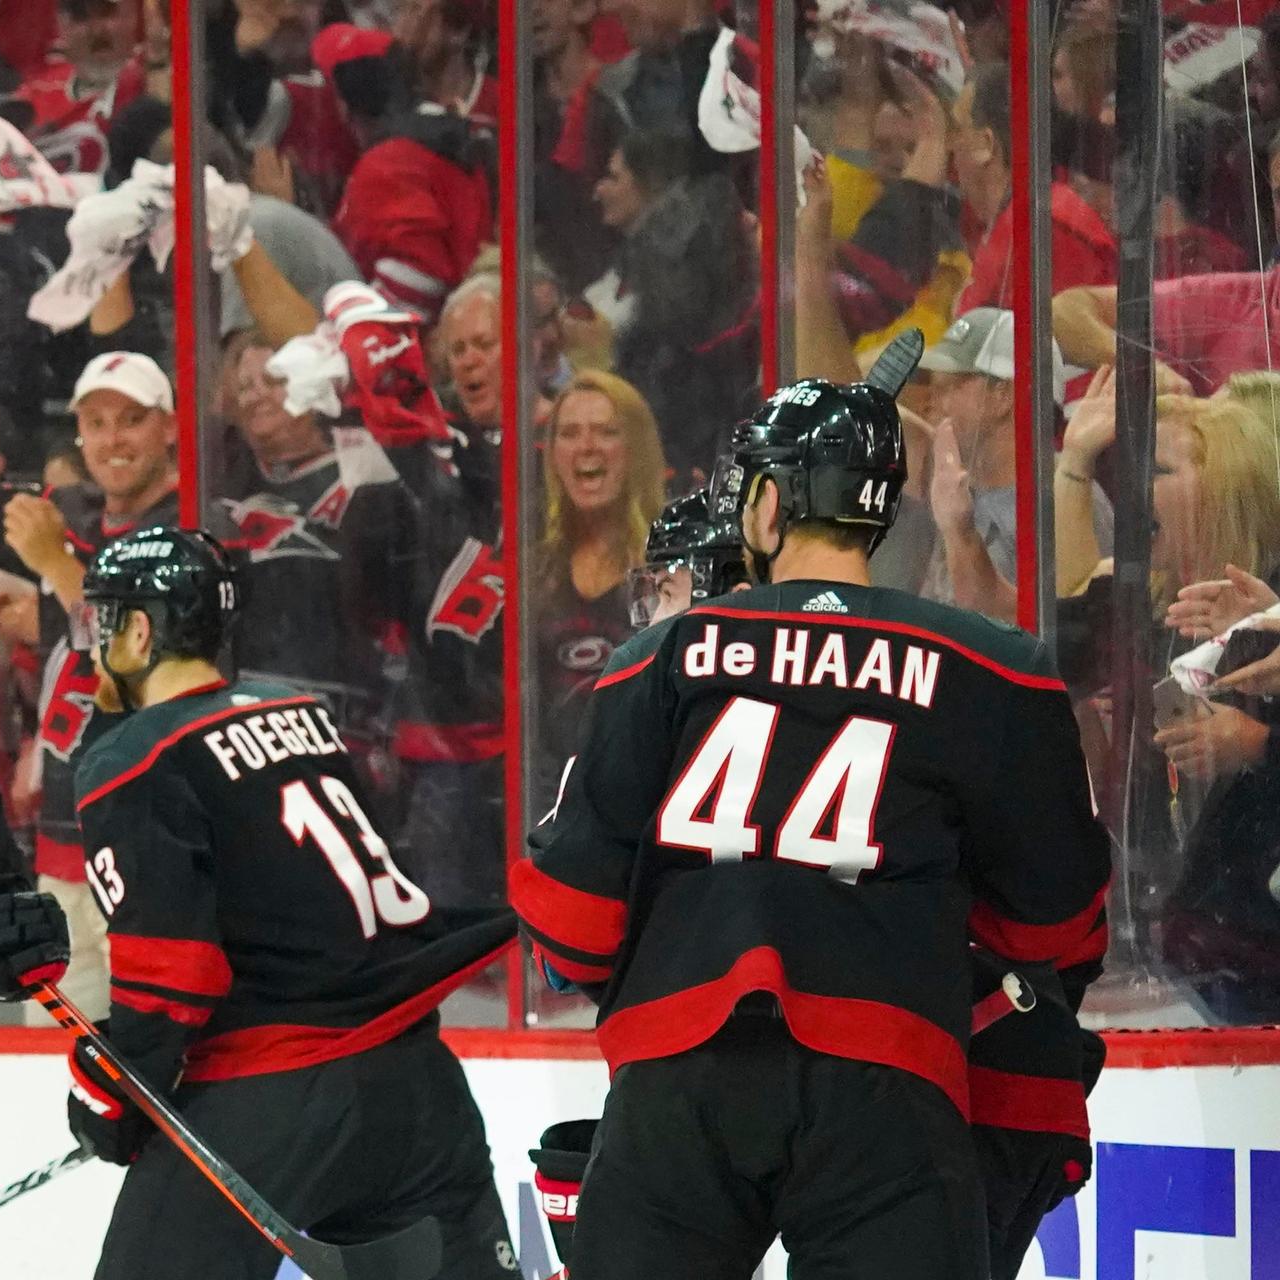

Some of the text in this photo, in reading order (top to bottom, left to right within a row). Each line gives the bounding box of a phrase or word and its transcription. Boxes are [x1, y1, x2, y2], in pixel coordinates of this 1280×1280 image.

[858, 478, 888, 514] 44
[217, 580, 236, 611] 13
[801, 600, 849, 614] adidas
[685, 623, 942, 711] de HAAN
[655, 694, 899, 887] 44
[84, 845, 126, 916] 13
[278, 773, 434, 940] 13
